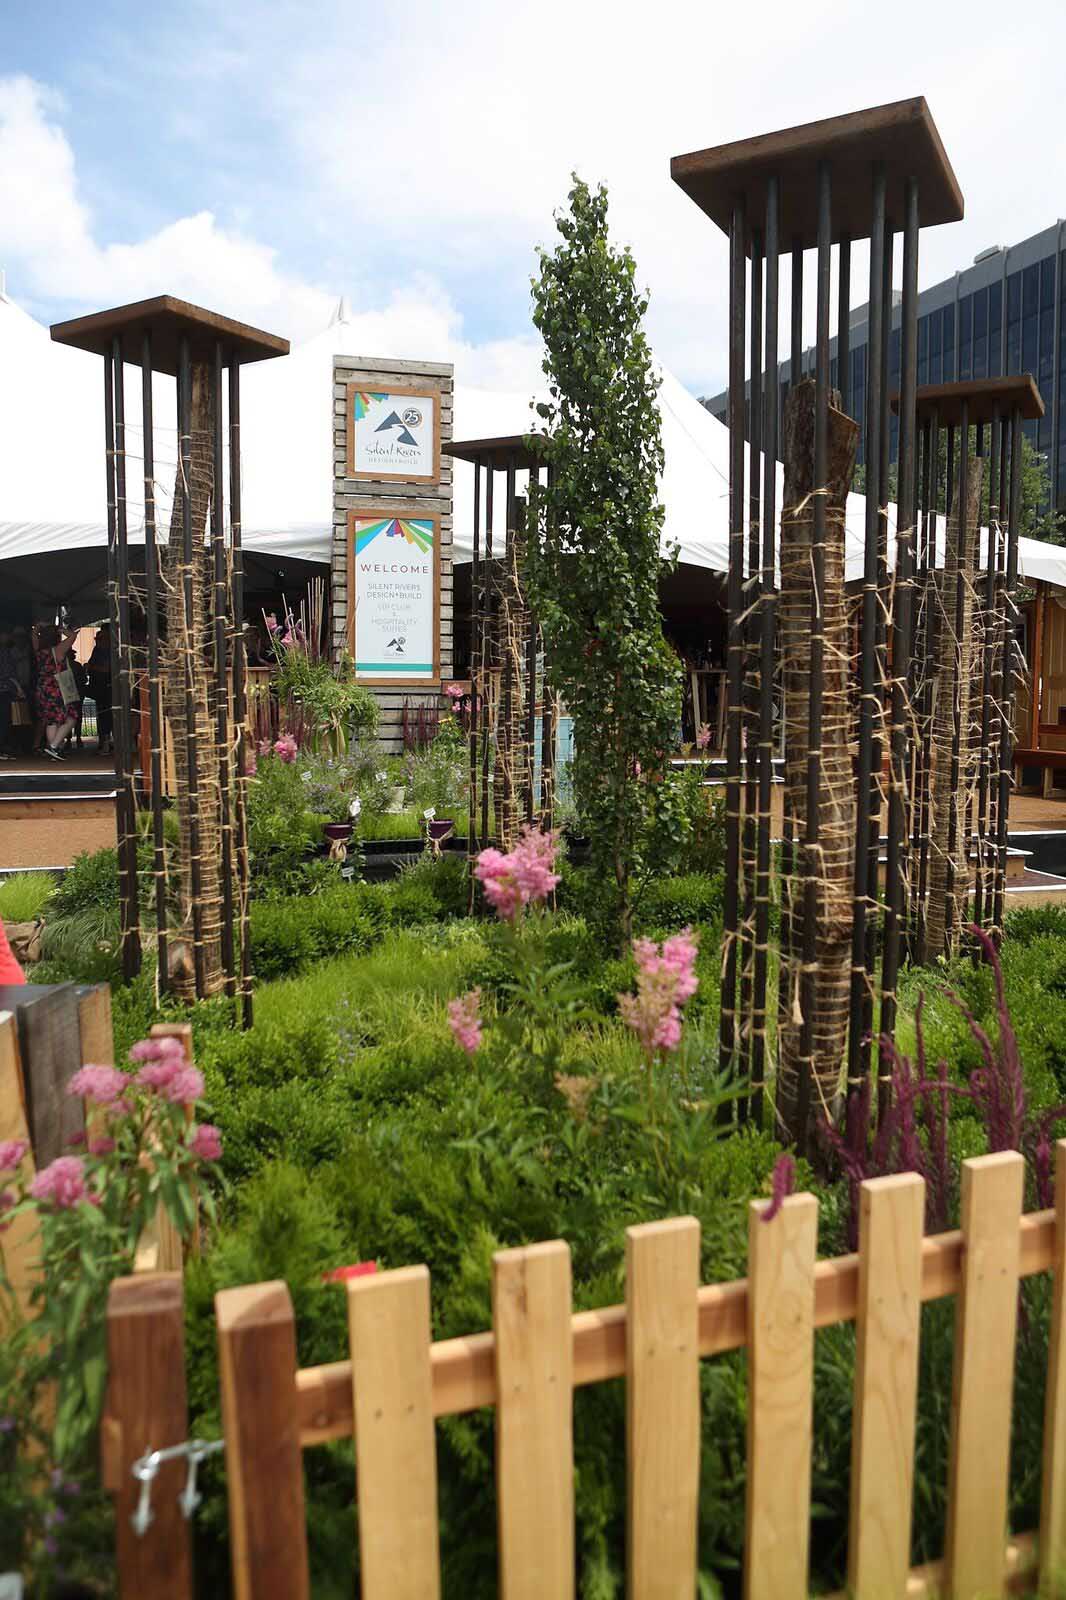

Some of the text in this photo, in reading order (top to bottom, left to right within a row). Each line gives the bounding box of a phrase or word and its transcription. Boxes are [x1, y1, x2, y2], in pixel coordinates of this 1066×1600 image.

[405, 411, 419, 422] 25
[365, 439, 422, 457] Silent Rivers
[360, 564, 429, 574] WELCOME
[367, 583, 421, 592] SILENT RIVERS
